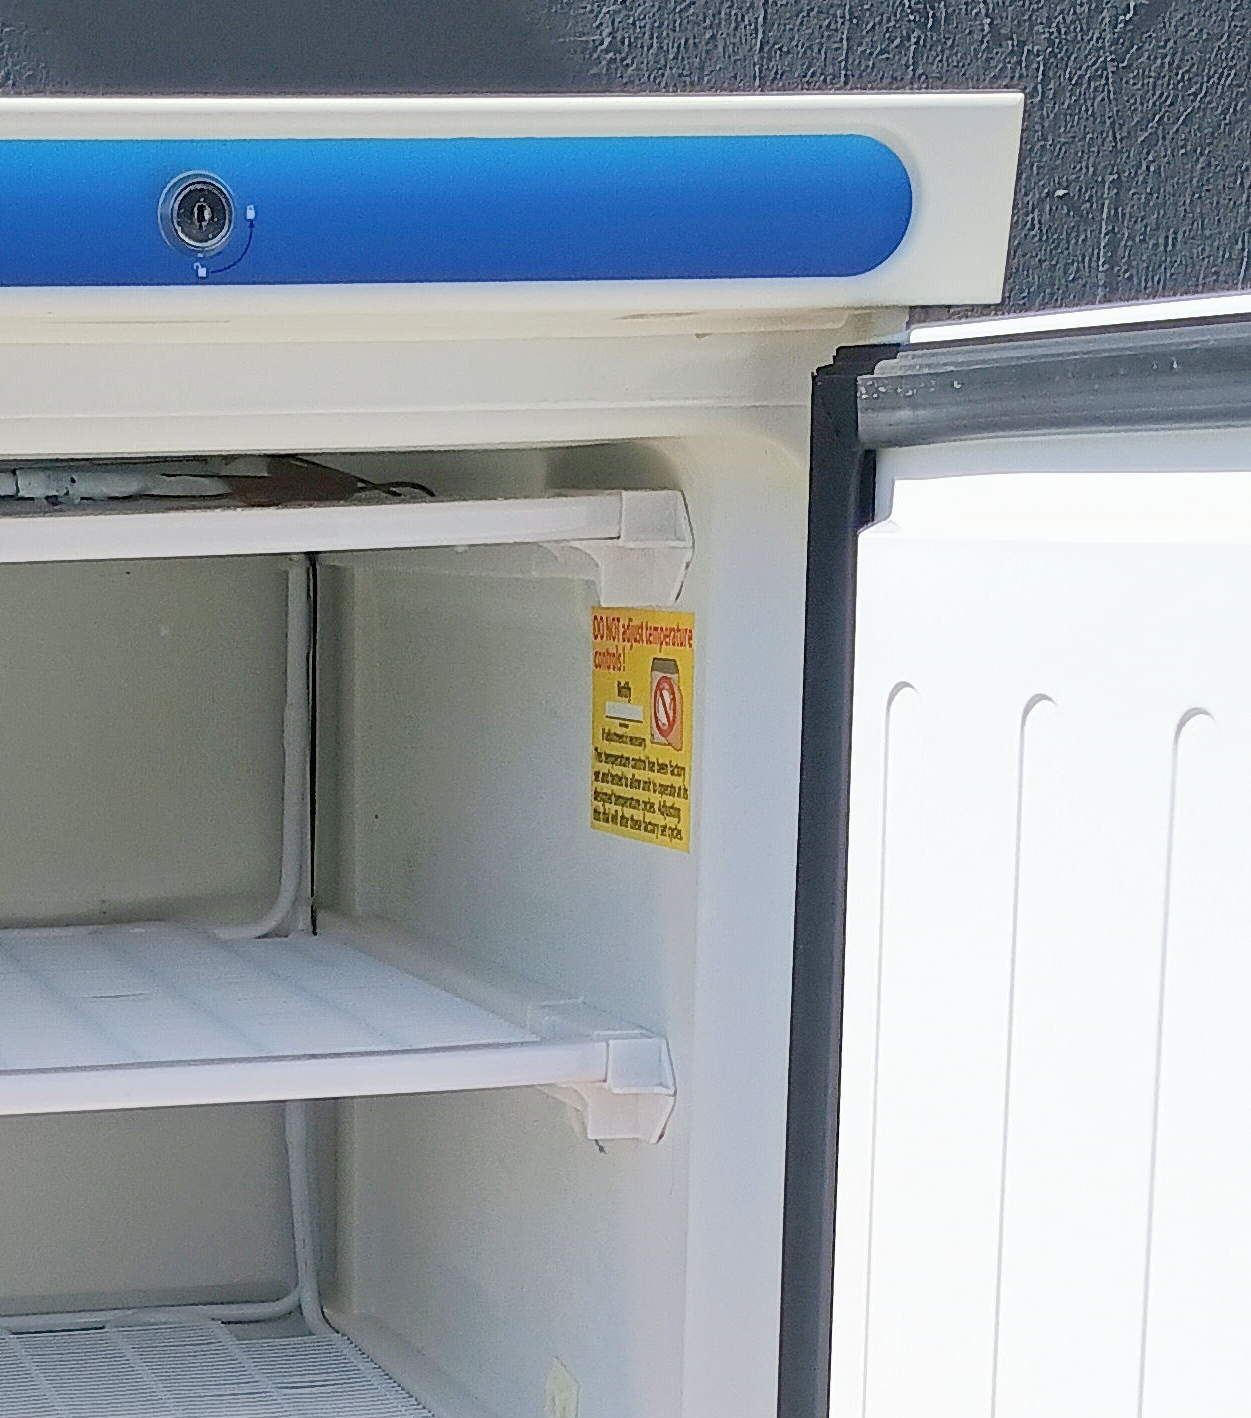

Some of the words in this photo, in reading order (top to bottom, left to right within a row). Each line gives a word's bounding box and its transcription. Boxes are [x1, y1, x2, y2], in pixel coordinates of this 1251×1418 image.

[593, 615, 605, 640] DO
[606, 616, 620, 642] NOT
[622, 617, 644, 650] adjust
[645, 620, 692, 653] temperature
